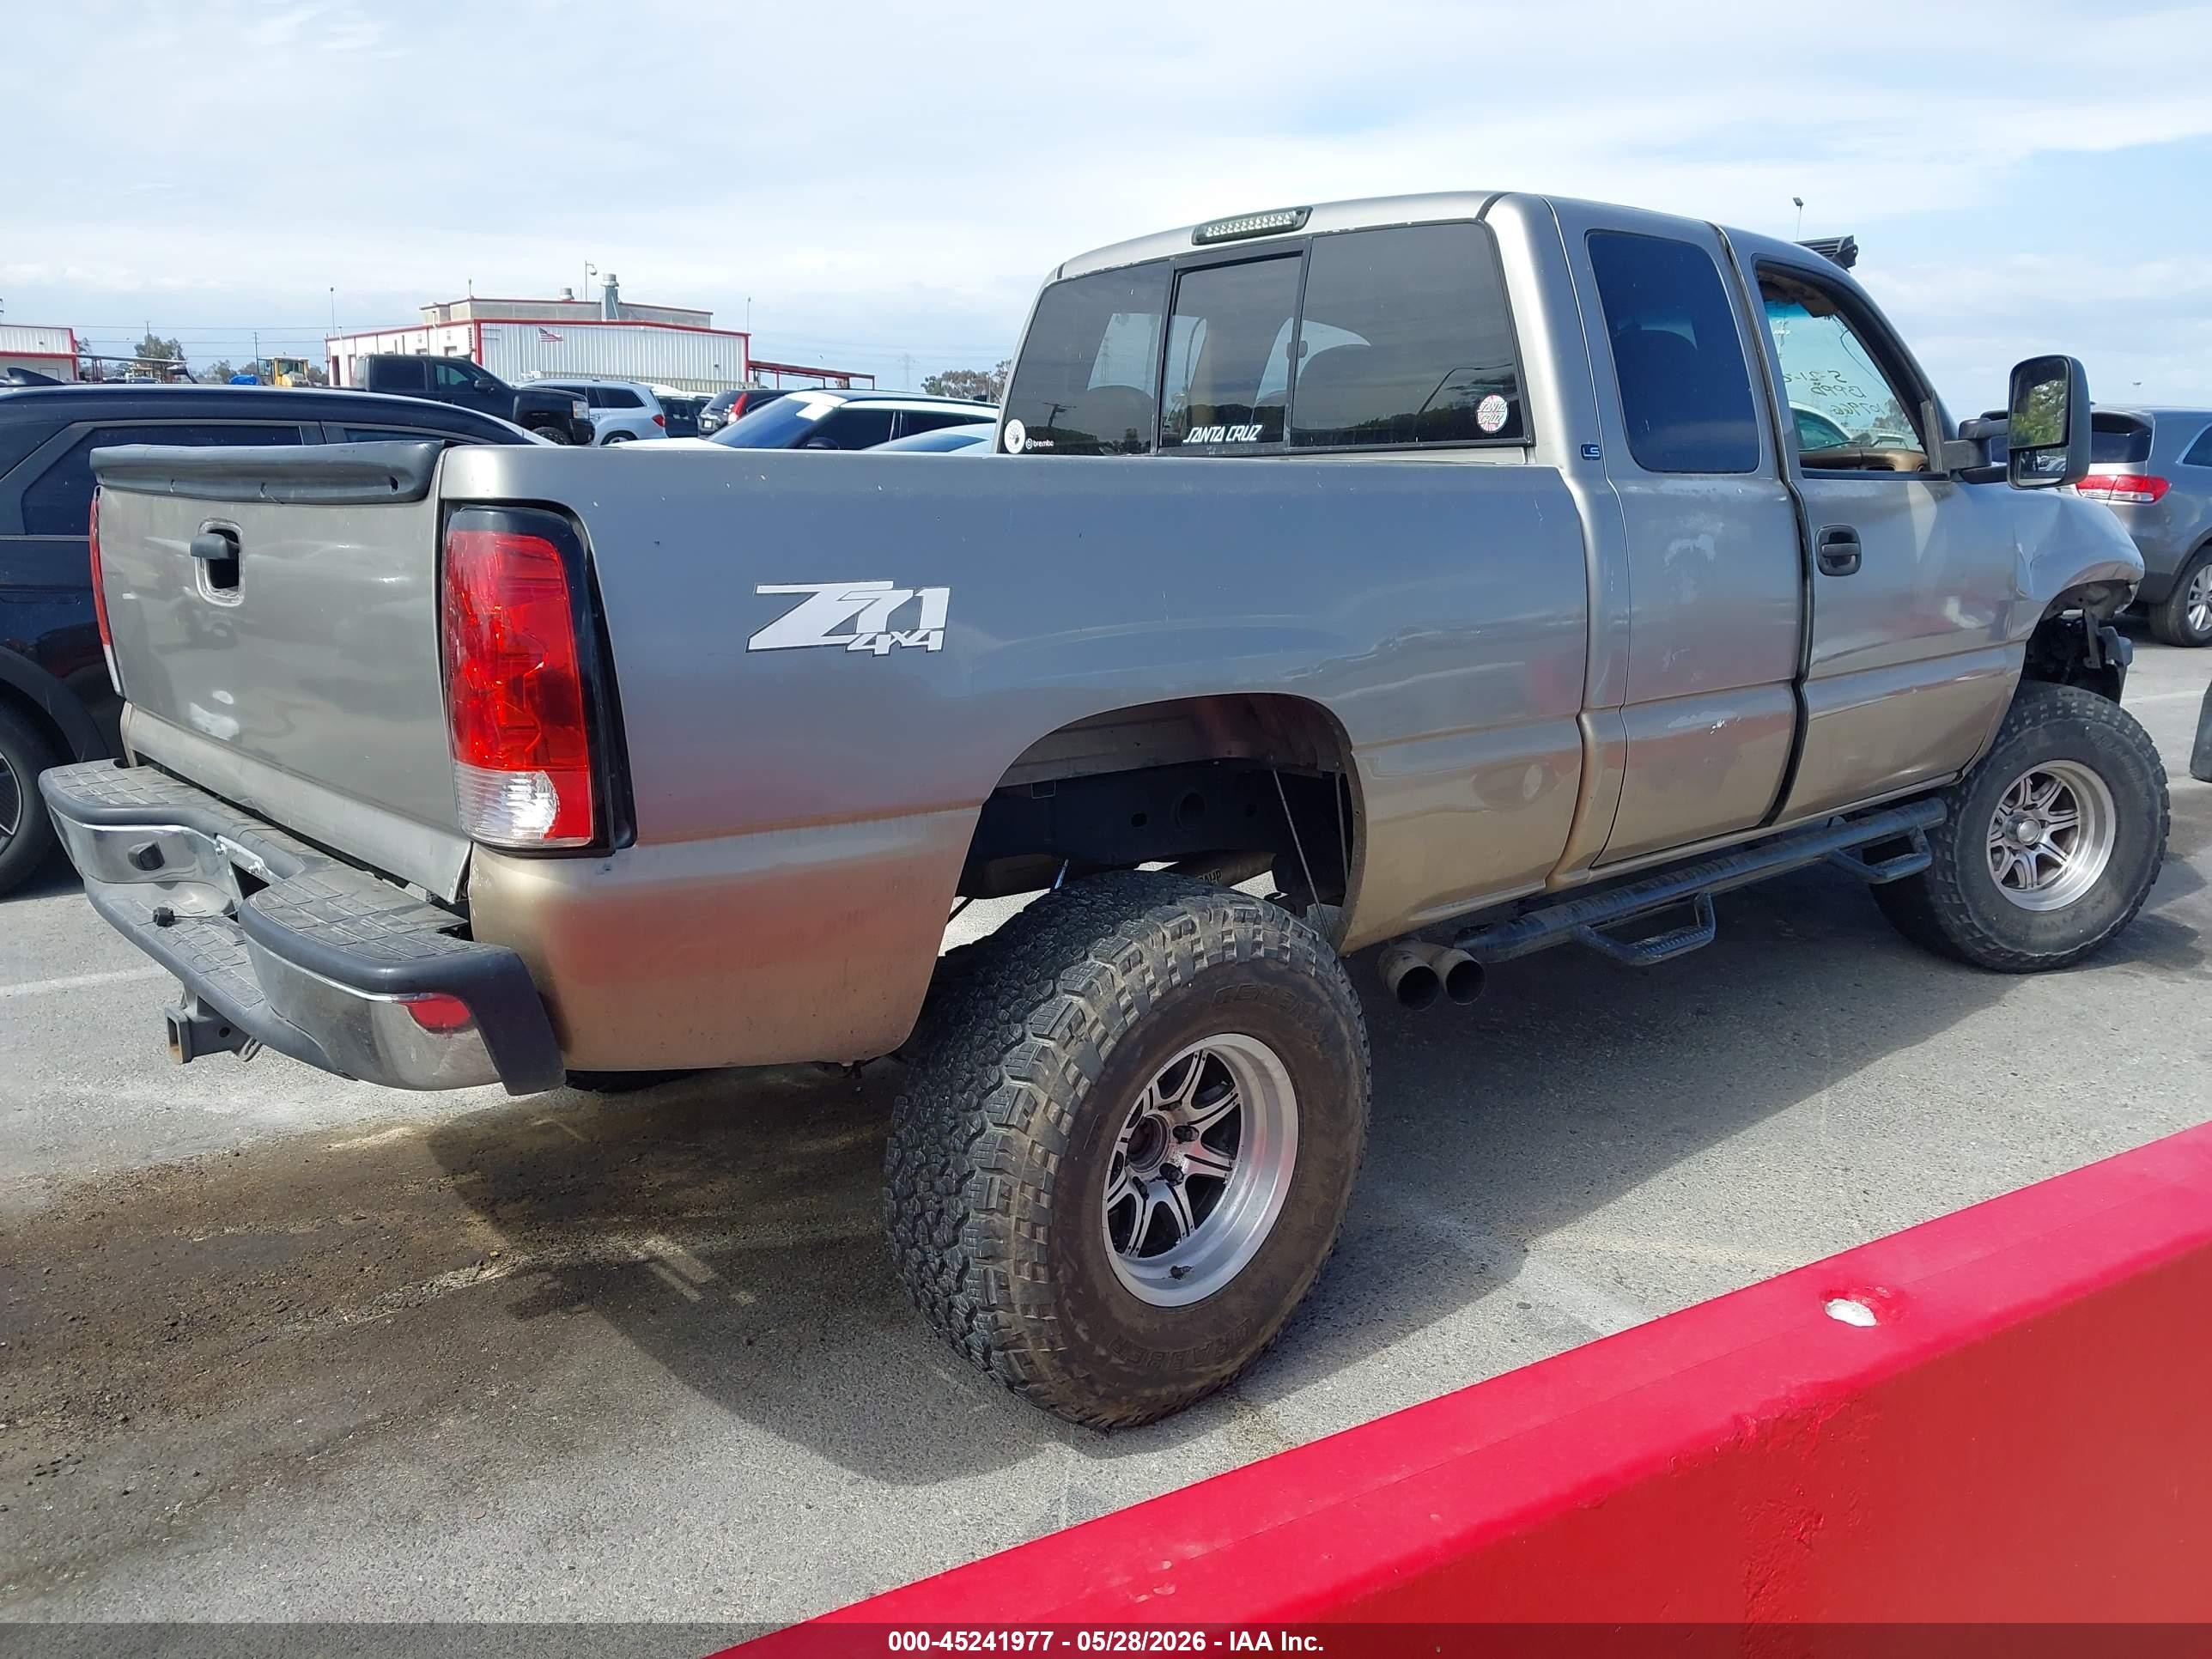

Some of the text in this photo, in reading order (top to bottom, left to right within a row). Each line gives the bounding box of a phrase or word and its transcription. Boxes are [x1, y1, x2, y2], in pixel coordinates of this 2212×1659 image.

[1477, 401, 1508, 412] SANTA
[1478, 413, 1503, 424] CRUZ
[1182, 424, 1263, 443] SANTA CRUZ
[1032, 439, 1054, 447] brembo
[1582, 446, 1601, 458] LS
[745, 580, 951, 653] Z71
[1108, 1318, 1251, 1371] GRABBER
